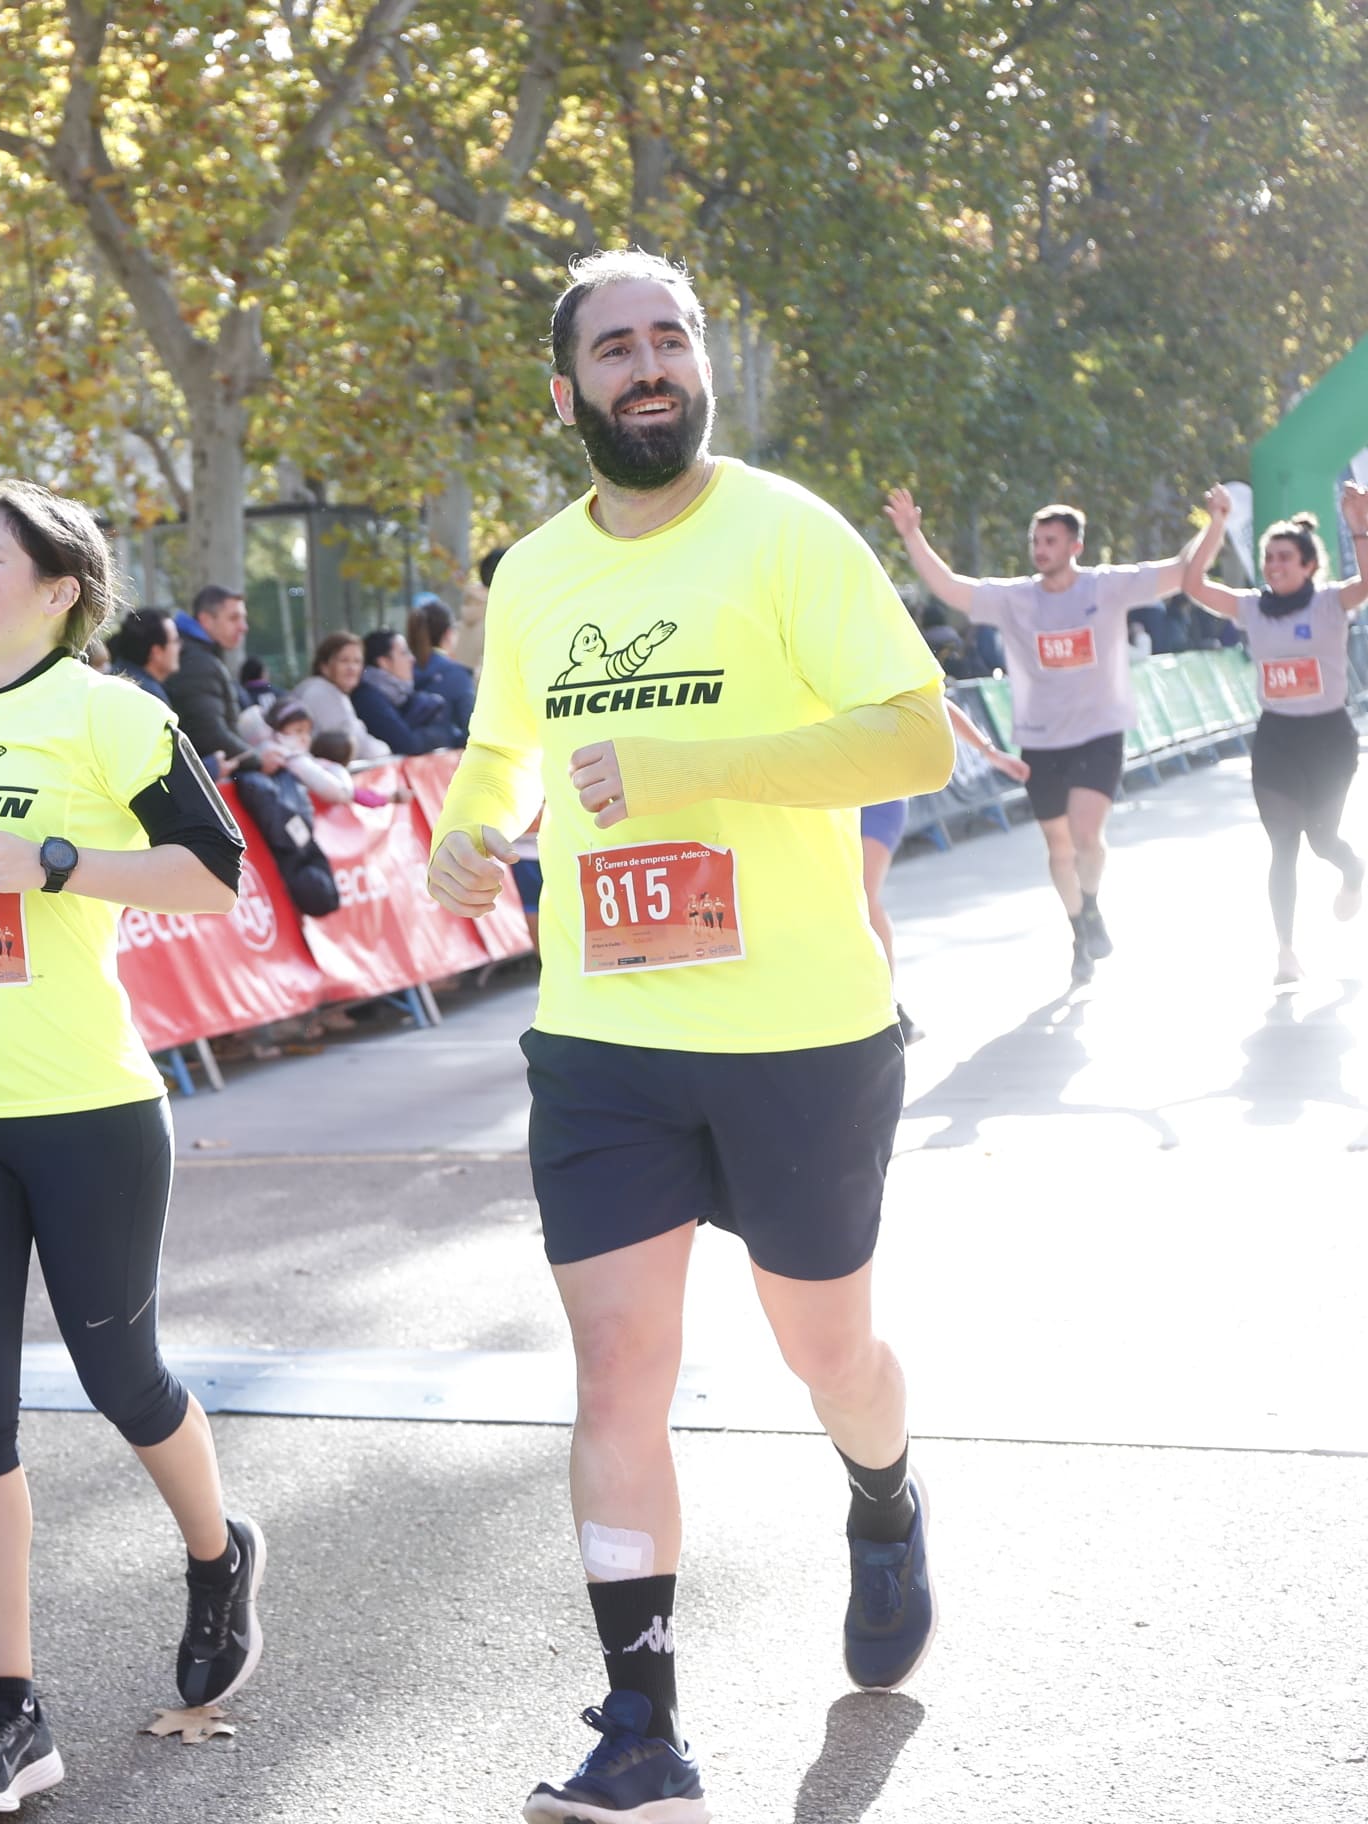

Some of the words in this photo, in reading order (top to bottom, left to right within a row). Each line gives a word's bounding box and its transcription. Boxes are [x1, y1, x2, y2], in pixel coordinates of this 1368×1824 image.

[545, 681, 724, 720] MICHELIN
[603, 861, 628, 870] Carrera
[629, 857, 640, 866] de
[640, 853, 678, 866] empresas
[680, 849, 711, 860] Adecco
[595, 867, 671, 928] 815
